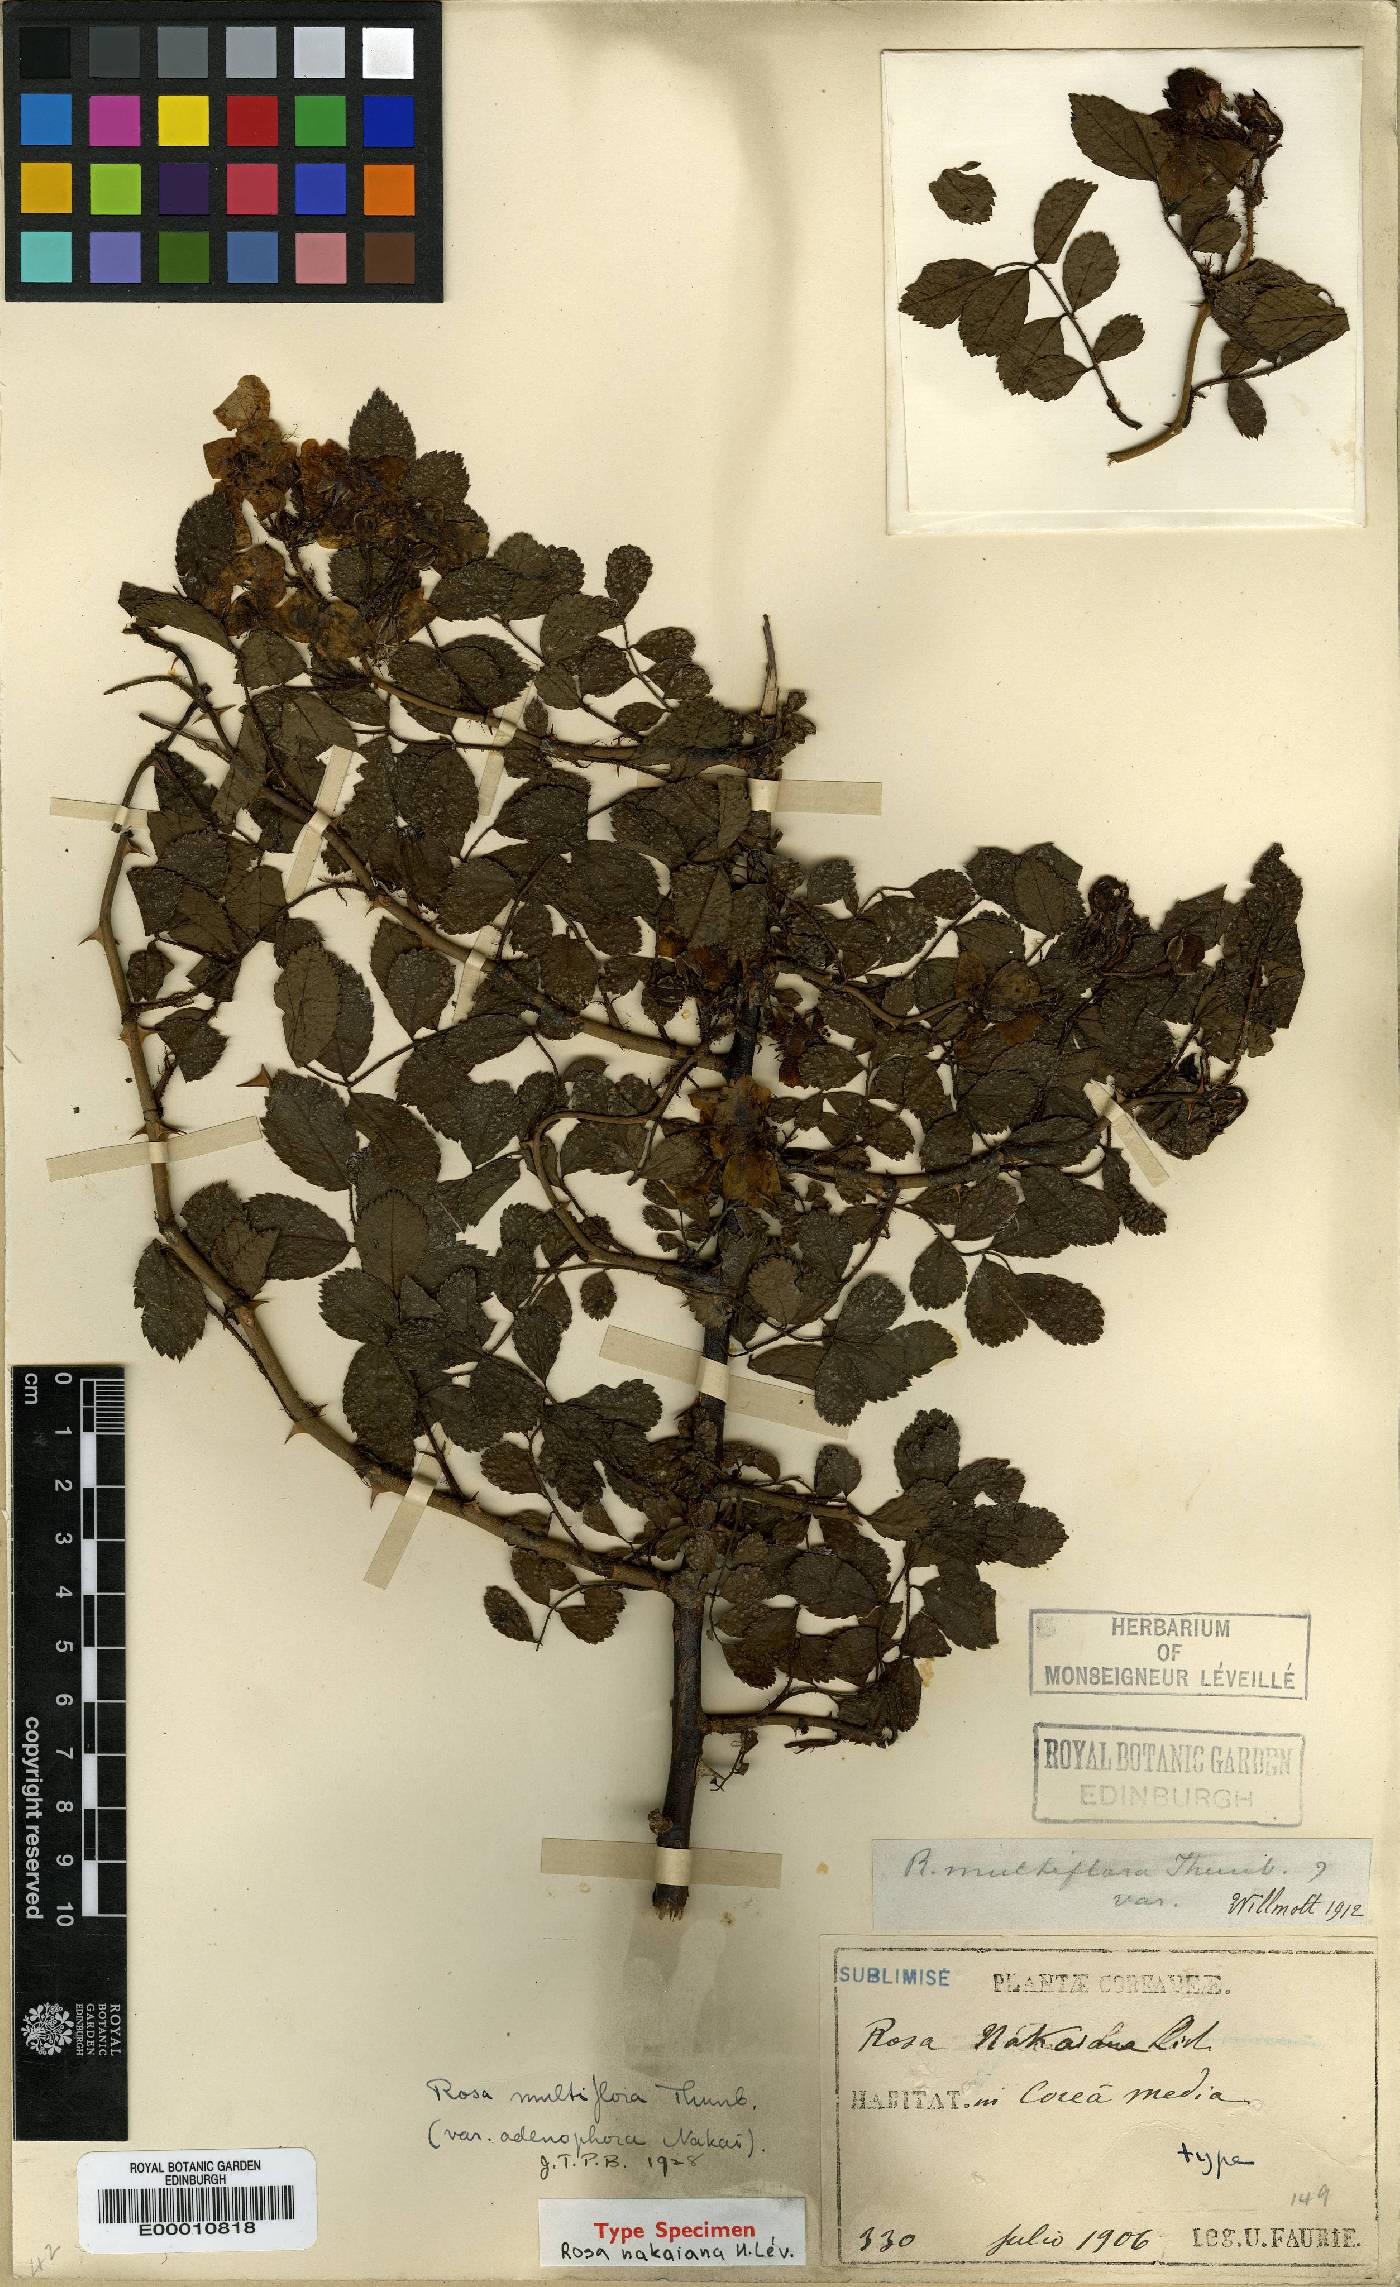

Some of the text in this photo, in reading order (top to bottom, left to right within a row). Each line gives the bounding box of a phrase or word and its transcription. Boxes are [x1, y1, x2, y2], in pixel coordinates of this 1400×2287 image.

[24, 1372, 38, 1405] cm
[54, 1372, 73, 1385] 0
[54, 1426, 73, 1435] 1
[54, 1479, 73, 1492] 2
[54, 1532, 73, 1545] 3
[55, 1585, 73, 1599] 4
[1111, 1617, 1231, 1638] HERBARIUM
[55, 1640, 74, 1653] 5
[1156, 1643, 1181, 1662] OF
[1044, 1661, 1296, 1690] MONSEIGNEUR LÉVEILLÉ
[55, 1693, 74, 1706] 6
[55, 1747, 74, 1760] 7
[1043, 1738, 1294, 1776] ROYAL BOTANIC GARDEN
[55, 1800, 74, 1813] 8
[1079, 1784, 1254, 1810] EDINBURGH
[22, 1716, 44, 1919] copyright reserved
[55, 1854, 74, 1867] 9
[56, 1902, 74, 1927] 10
[1325, 1900, 1365, 1921] 1912
[75, 2003, 84, 2056] EDINBURGH
[86, 2003, 95, 2056] GARDEN
[98, 2003, 107, 2056] BOTANIC
[110, 2003, 121, 2056] ROYAL
[857, 2016, 946, 2052] Rosa
[426, 2078, 494, 2102] Rosa
[509, 2074, 648, 2123] multiflora
[130, 2160, 261, 2174] ROYAL BOTANIC GARDEN
[1177, 2142, 1255, 2180] type
[165, 2174, 227, 2186] EDINBURGH
[139, 2222, 257, 2236] E00010818
[594, 2221, 756, 2244] Type Specimen
[561, 2242, 610, 2260] Rosa
[622, 2242, 725, 2260] nakaiana
[1075, 2229, 1154, 2253] 1906
